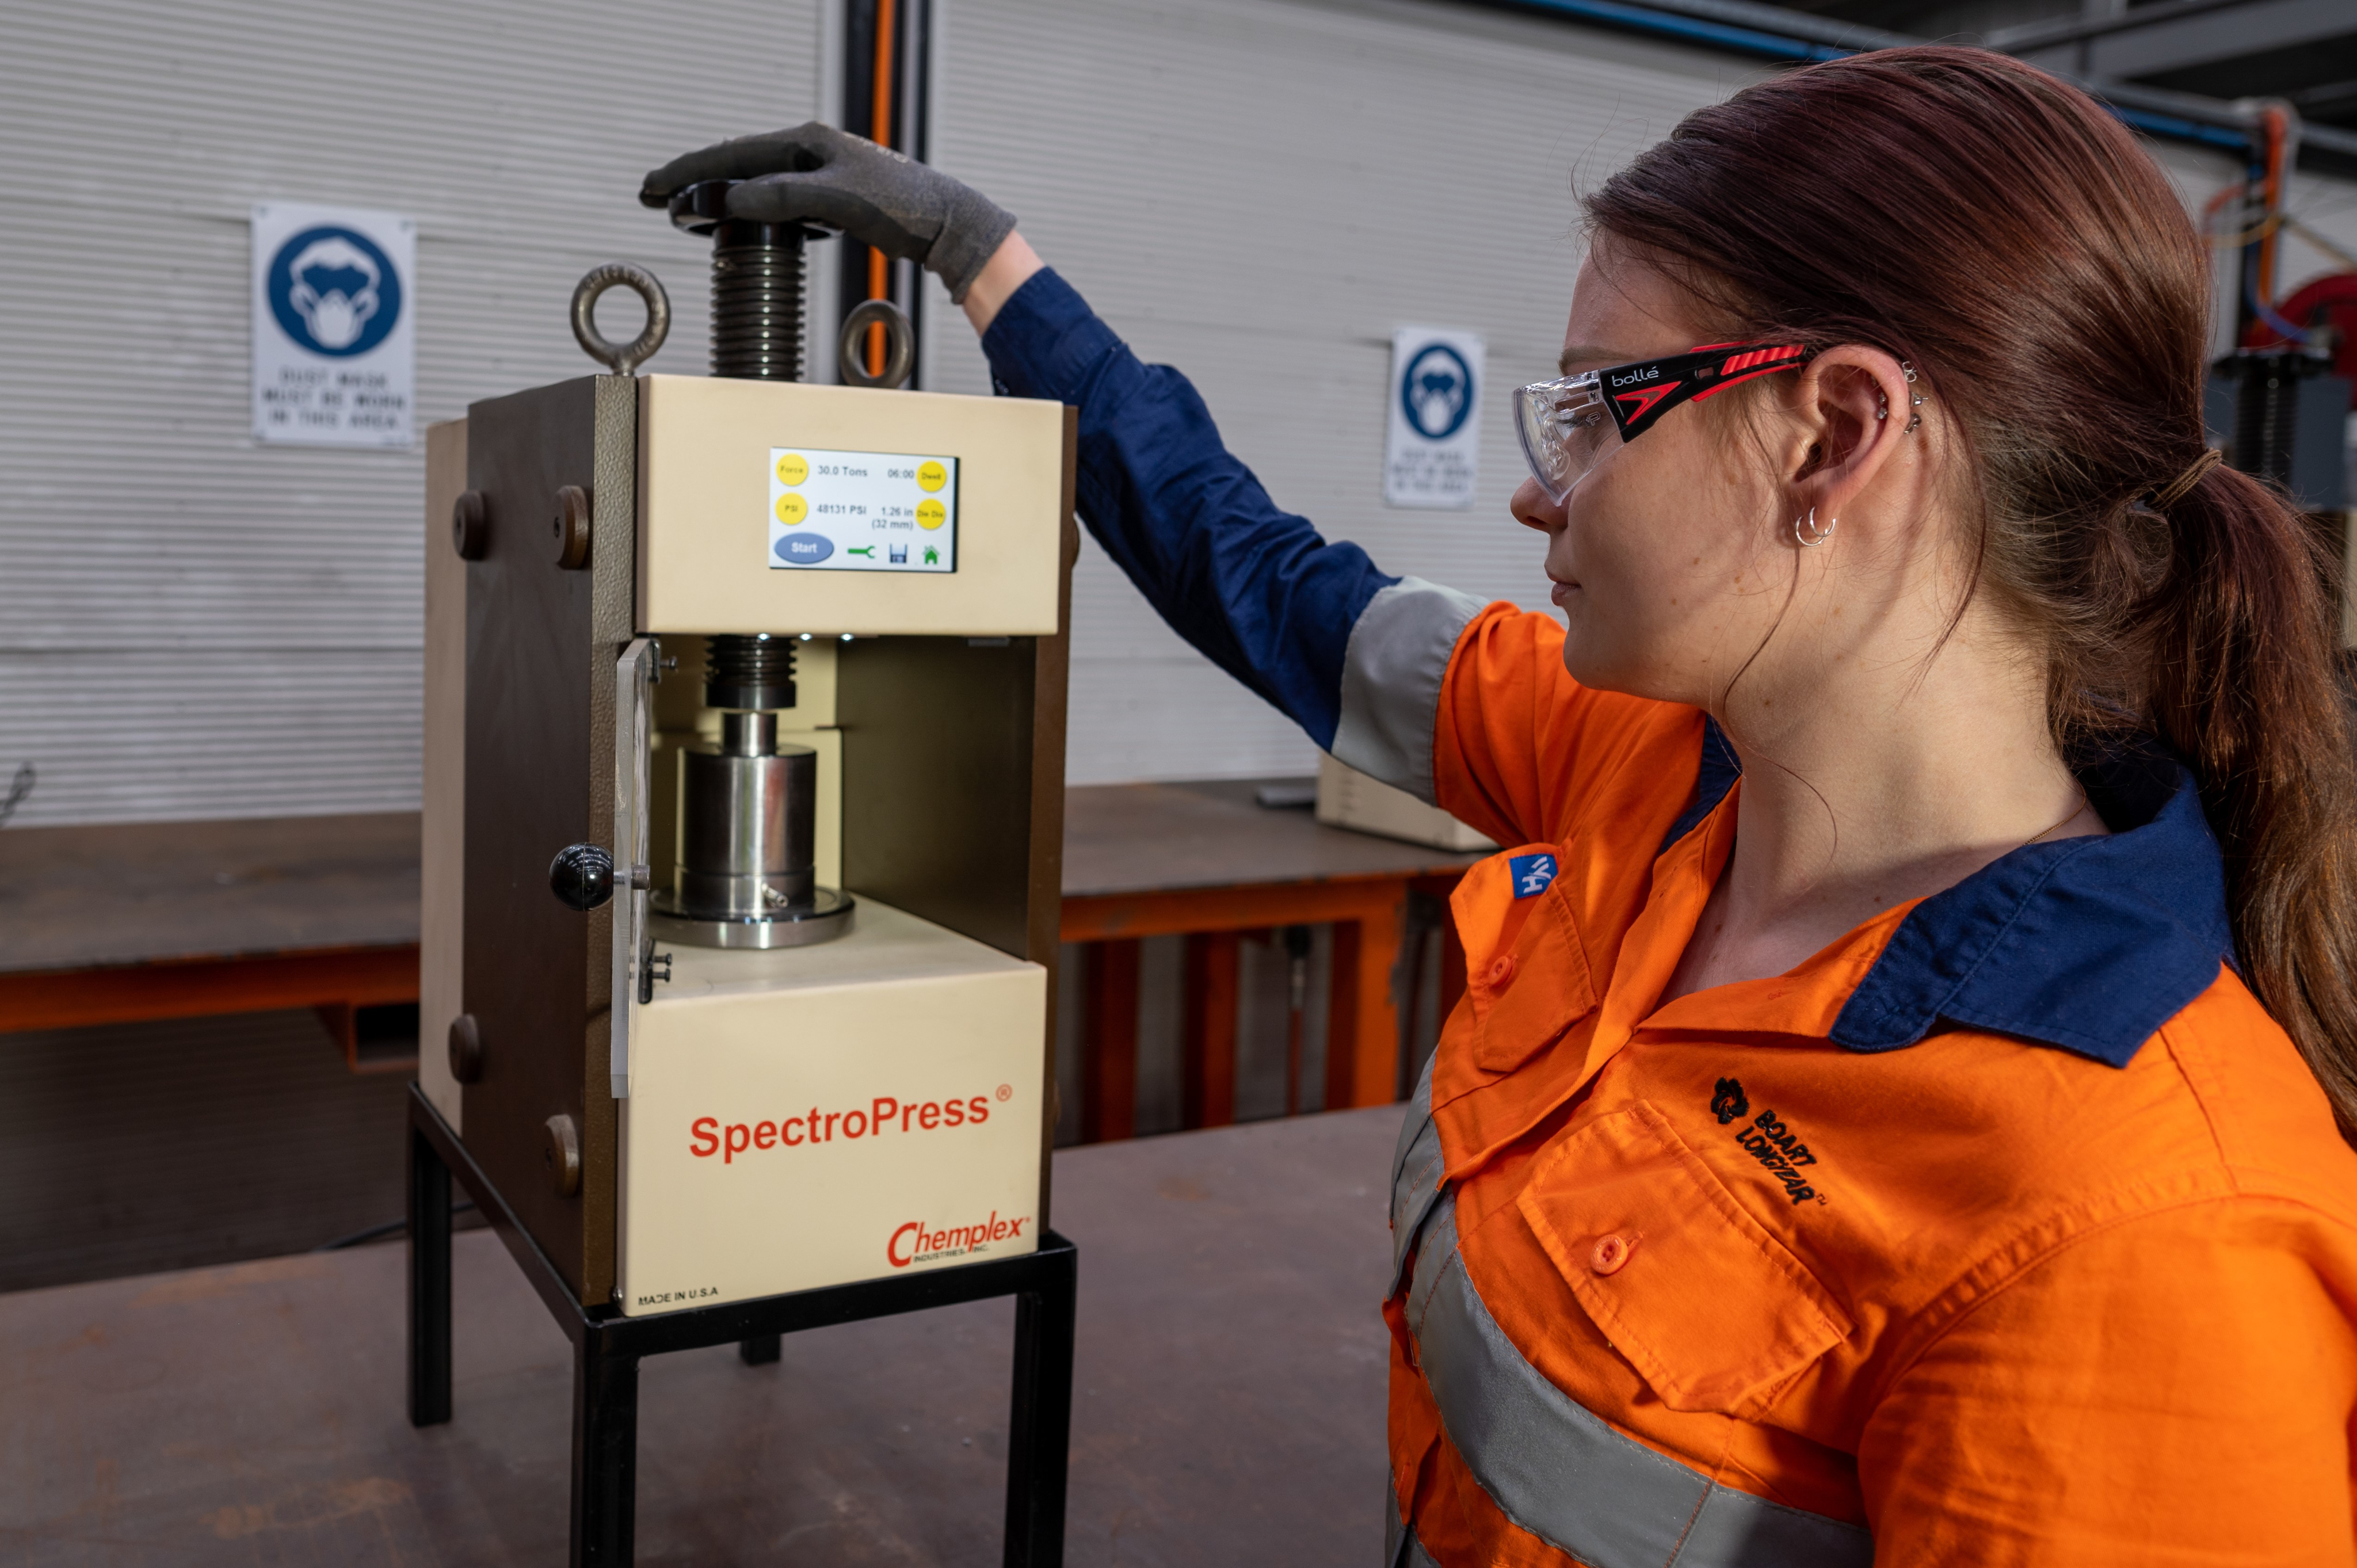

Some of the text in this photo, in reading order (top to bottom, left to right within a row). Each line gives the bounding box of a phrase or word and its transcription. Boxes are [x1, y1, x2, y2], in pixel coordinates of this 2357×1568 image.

[1612, 365, 1659, 387] bollé
[780, 465, 803, 474] Force
[818, 465, 868, 477] 30.0 Tons
[887, 469, 915, 479] 06:00
[784, 505, 798, 513] PSI
[817, 504, 867, 516] 48131 PSI
[881, 506, 913, 517] 1.26 in
[871, 518, 914, 531] (32 mm)
[791, 542, 818, 554] Start
[1755, 1109, 1817, 1166] BOART
[674, 1291, 685, 1301] IN
